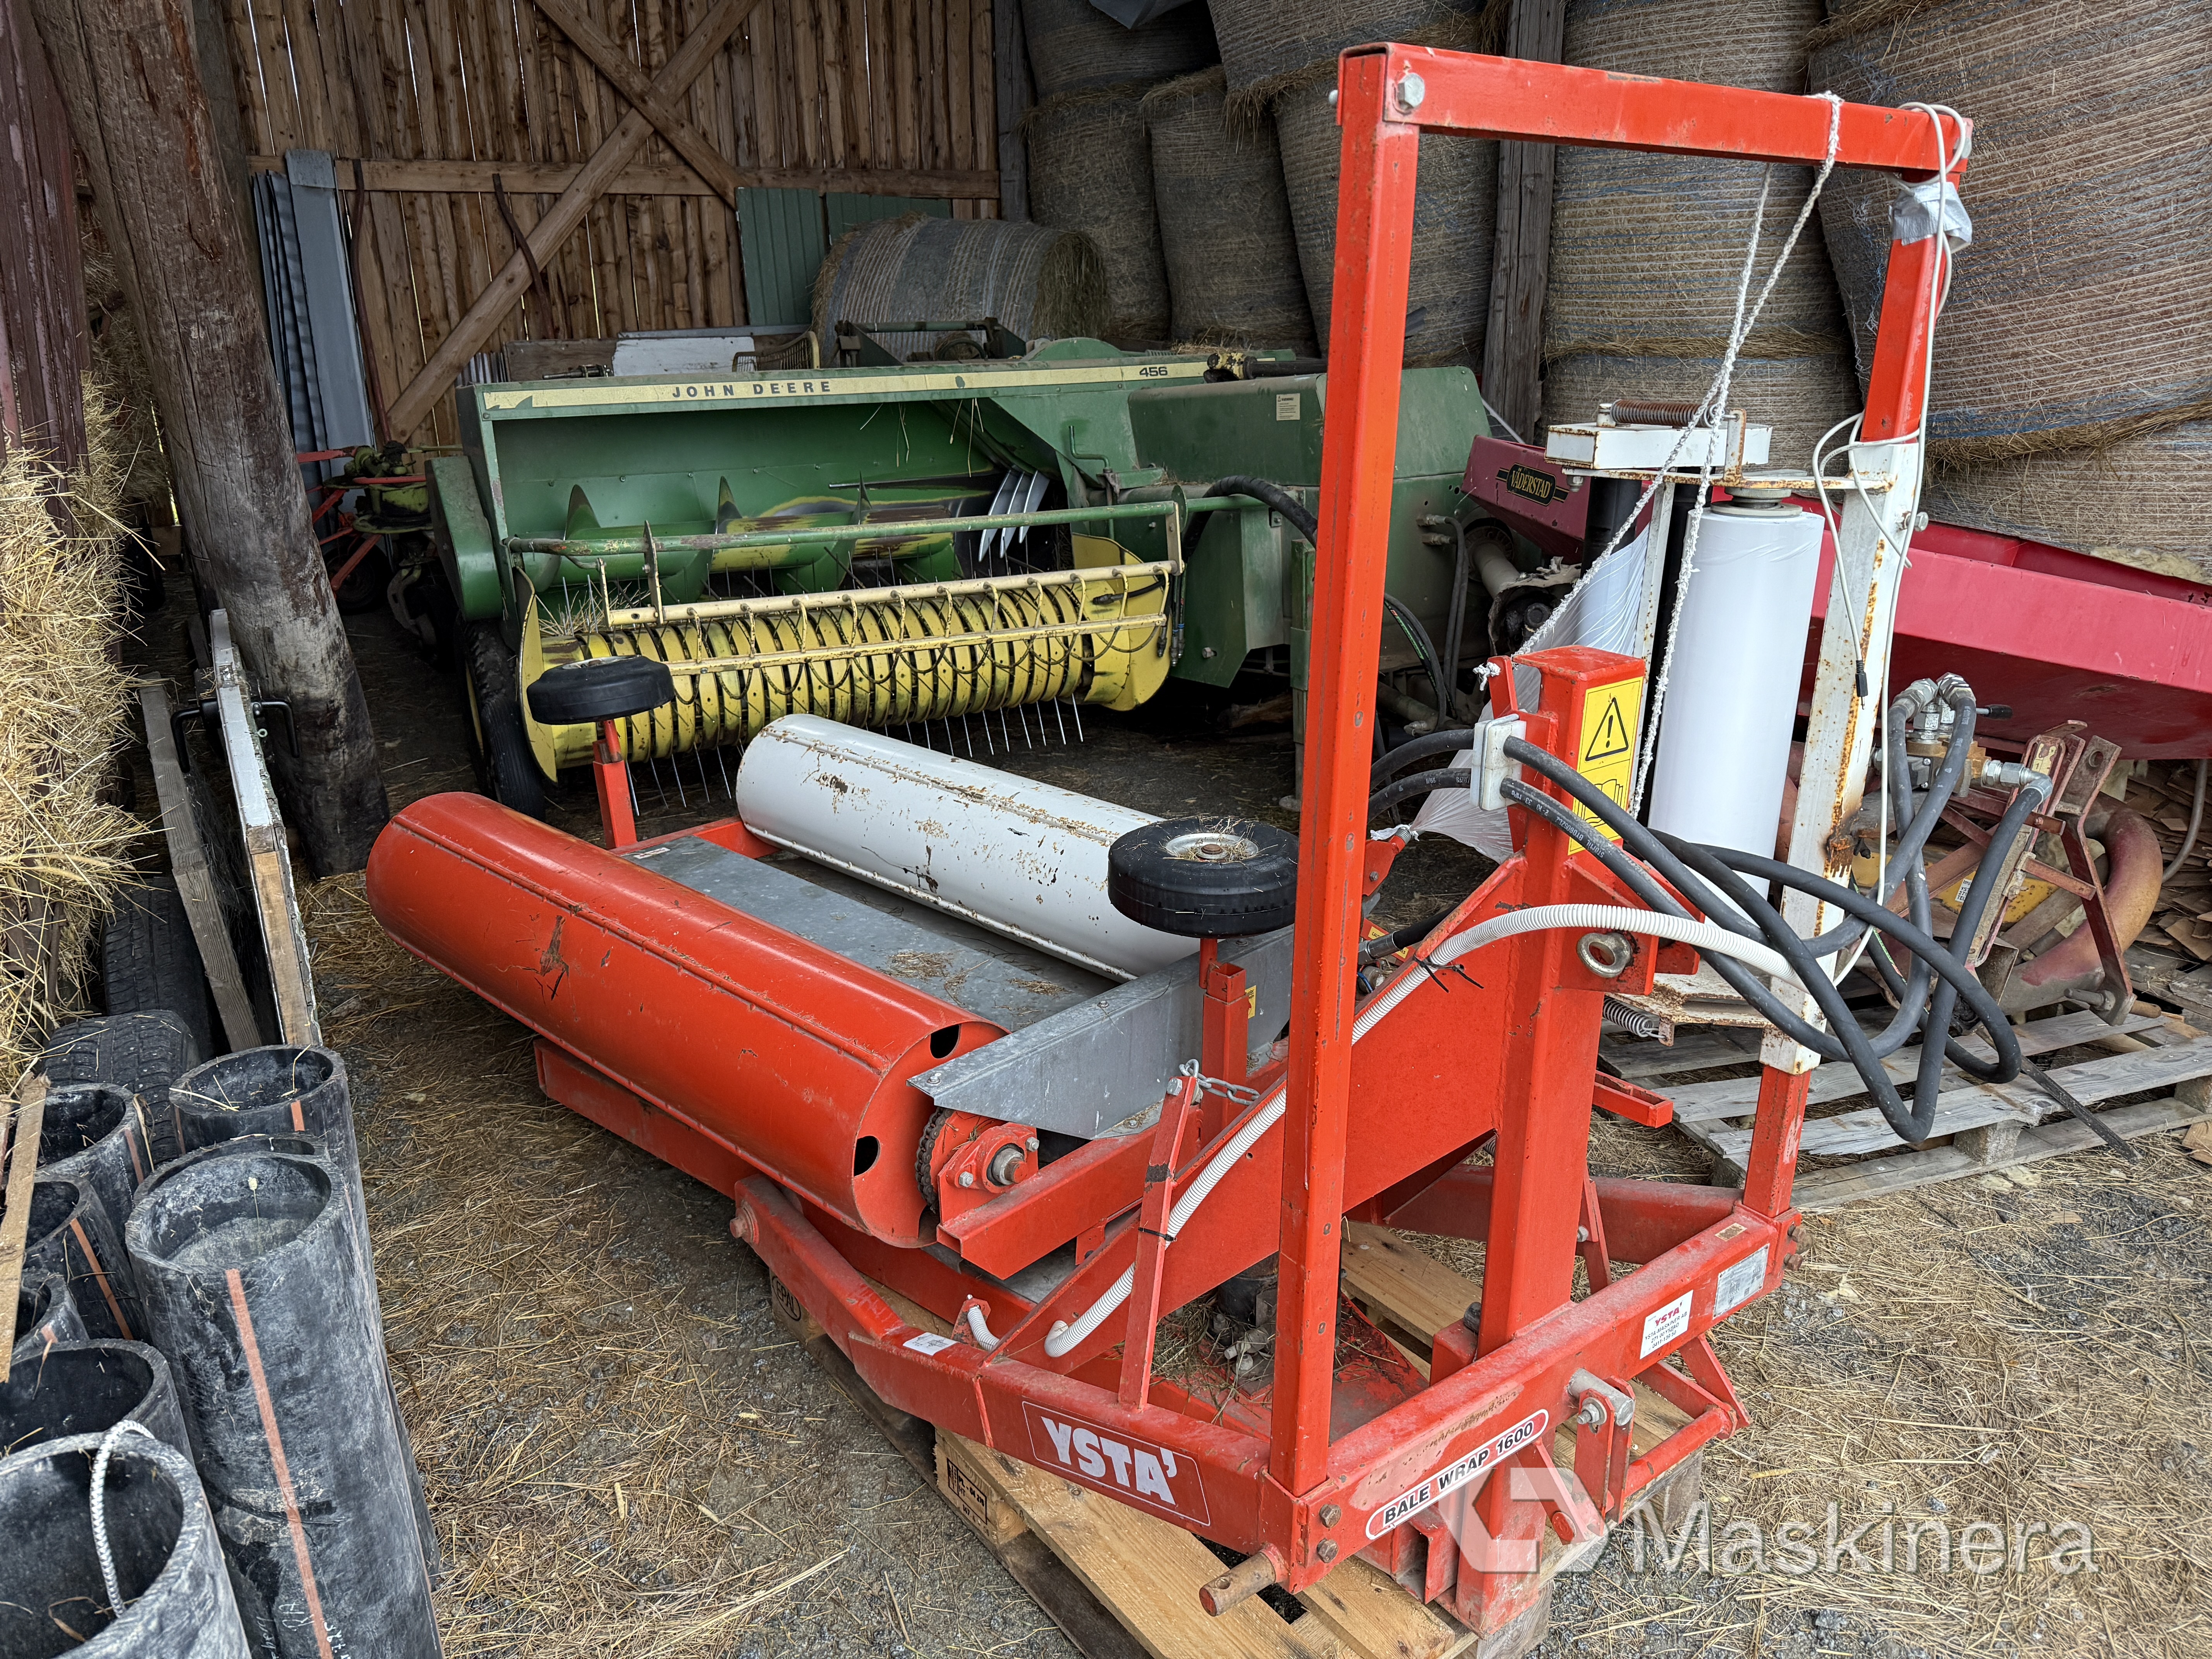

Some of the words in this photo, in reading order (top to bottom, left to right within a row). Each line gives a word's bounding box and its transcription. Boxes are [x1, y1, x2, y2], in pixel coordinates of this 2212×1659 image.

[1139, 366, 1168, 377] 456
[672, 385, 734, 398] JOHN
[752, 381, 830, 395] DEERE
[1511, 468, 1551, 498] VÄDERSTAD
[1525, 797, 1532, 806] 33
[1586, 839, 1604, 858] STOMIL
[1385, 1486, 1429, 1524] BALE
[1439, 1450, 1489, 1490] WRAP
[1497, 1422, 1533, 1453] 1600
